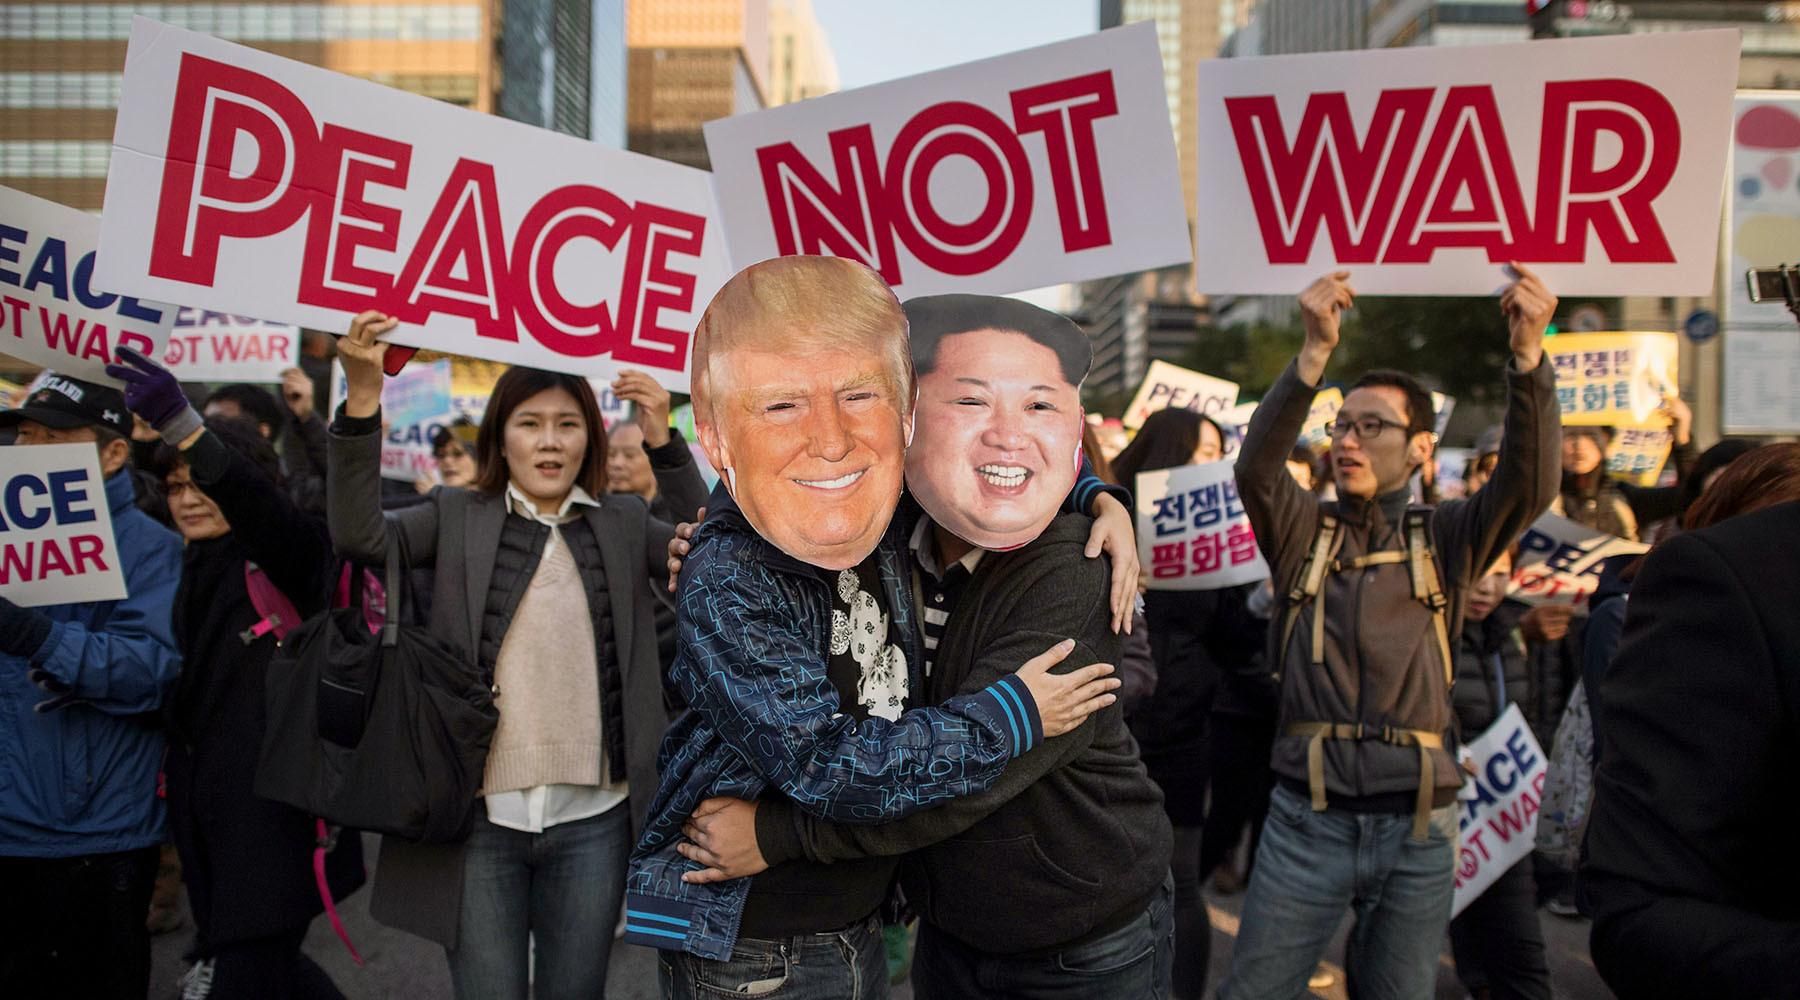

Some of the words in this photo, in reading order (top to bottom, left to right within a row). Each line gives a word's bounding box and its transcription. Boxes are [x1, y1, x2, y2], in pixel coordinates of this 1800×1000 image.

[149, 51, 706, 373] PEACE
[756, 69, 1118, 287] NOT
[1224, 78, 1678, 265] WAR
[210, 335, 290, 362] WAR
[0, 468, 97, 532] CE
